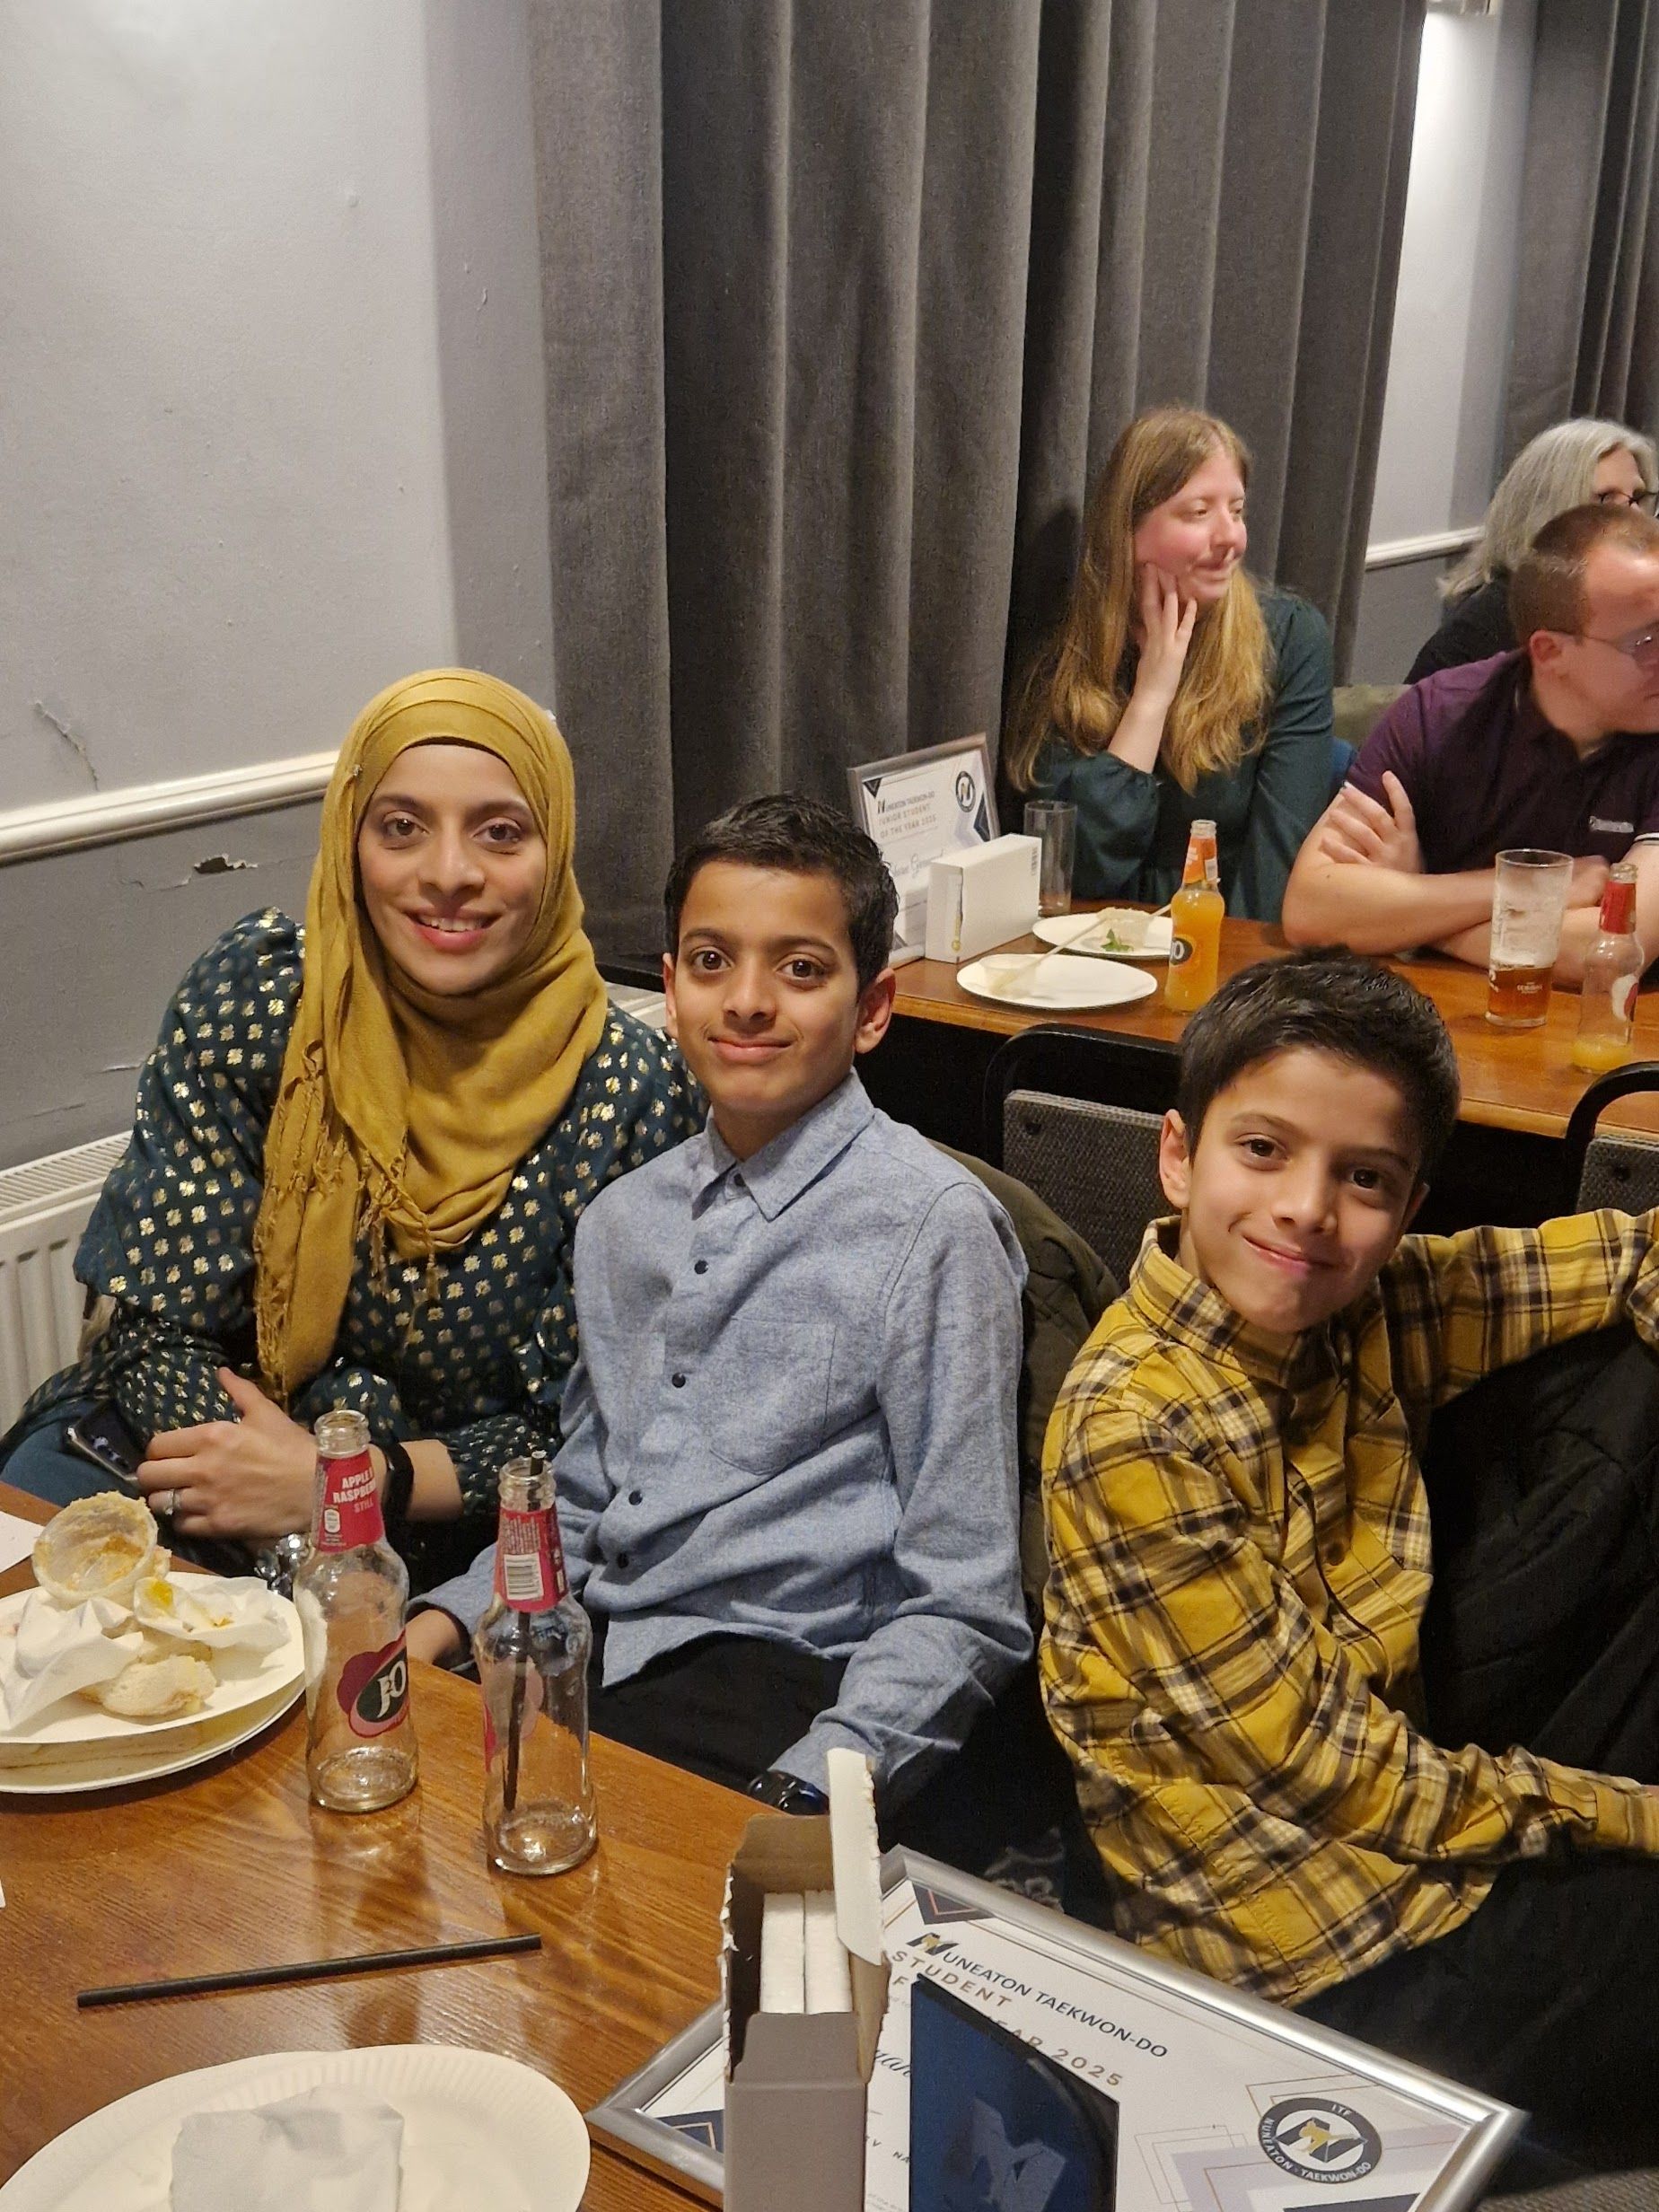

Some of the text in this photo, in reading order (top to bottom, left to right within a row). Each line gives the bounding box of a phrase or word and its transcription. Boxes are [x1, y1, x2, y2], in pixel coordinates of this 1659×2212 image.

[890, 824, 902, 835] THE
[903, 819, 919, 830] YEAR
[891, 1950, 1013, 2007] STUDENT
[1034, 1990, 1168, 2058] TAEKWON-DO
[1050, 2048, 1124, 2087] 2025
[1330, 2103, 1351, 2117] ITF
[1261, 2118, 1372, 2182] NUNEATON TAEKWON-DO
